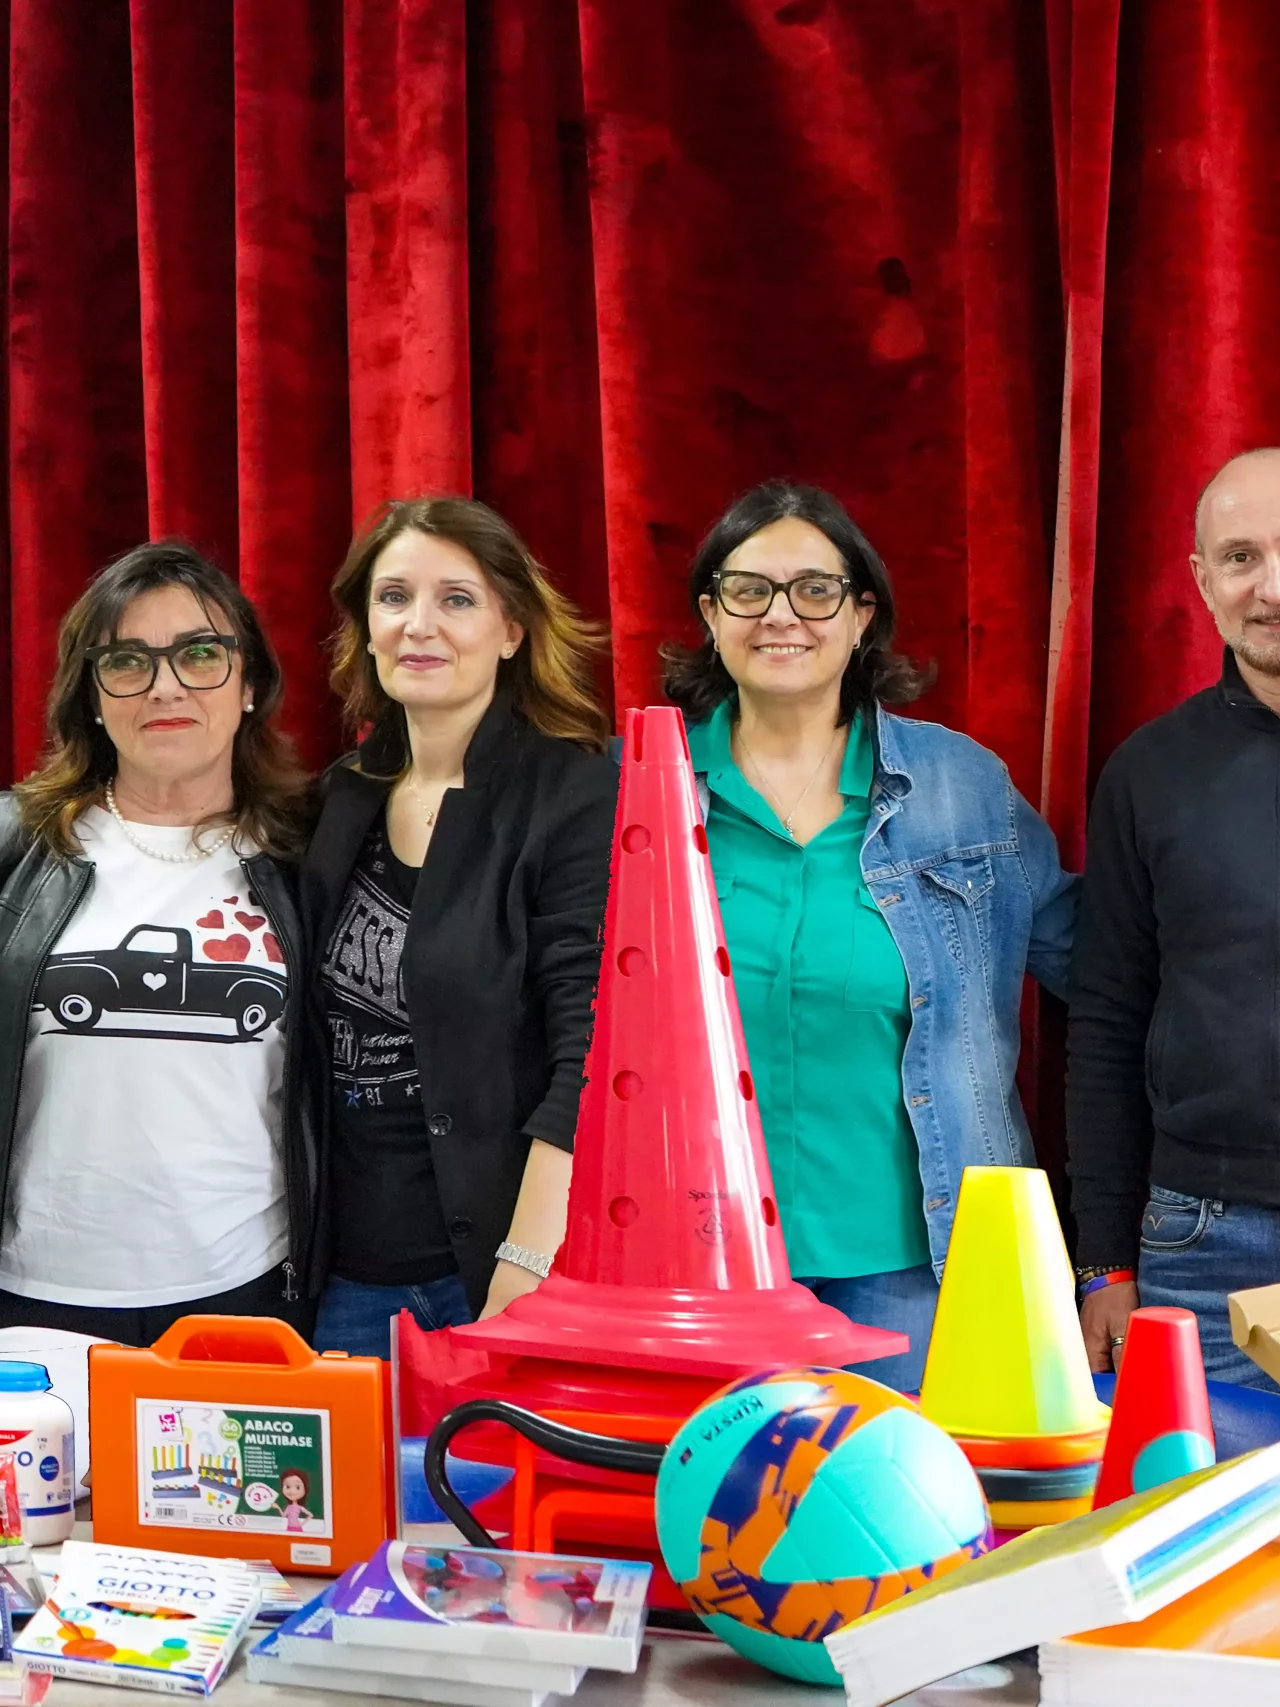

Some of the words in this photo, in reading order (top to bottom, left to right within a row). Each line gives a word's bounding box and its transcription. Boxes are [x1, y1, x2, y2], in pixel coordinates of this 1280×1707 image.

[365, 1087, 384, 1106] 81
[245, 1419, 293, 1433] ABACO
[245, 1433, 313, 1448] MULTIBASE
[98, 1577, 216, 1600] GIOTTO
[27, 1661, 66, 1674] GIOTTO
